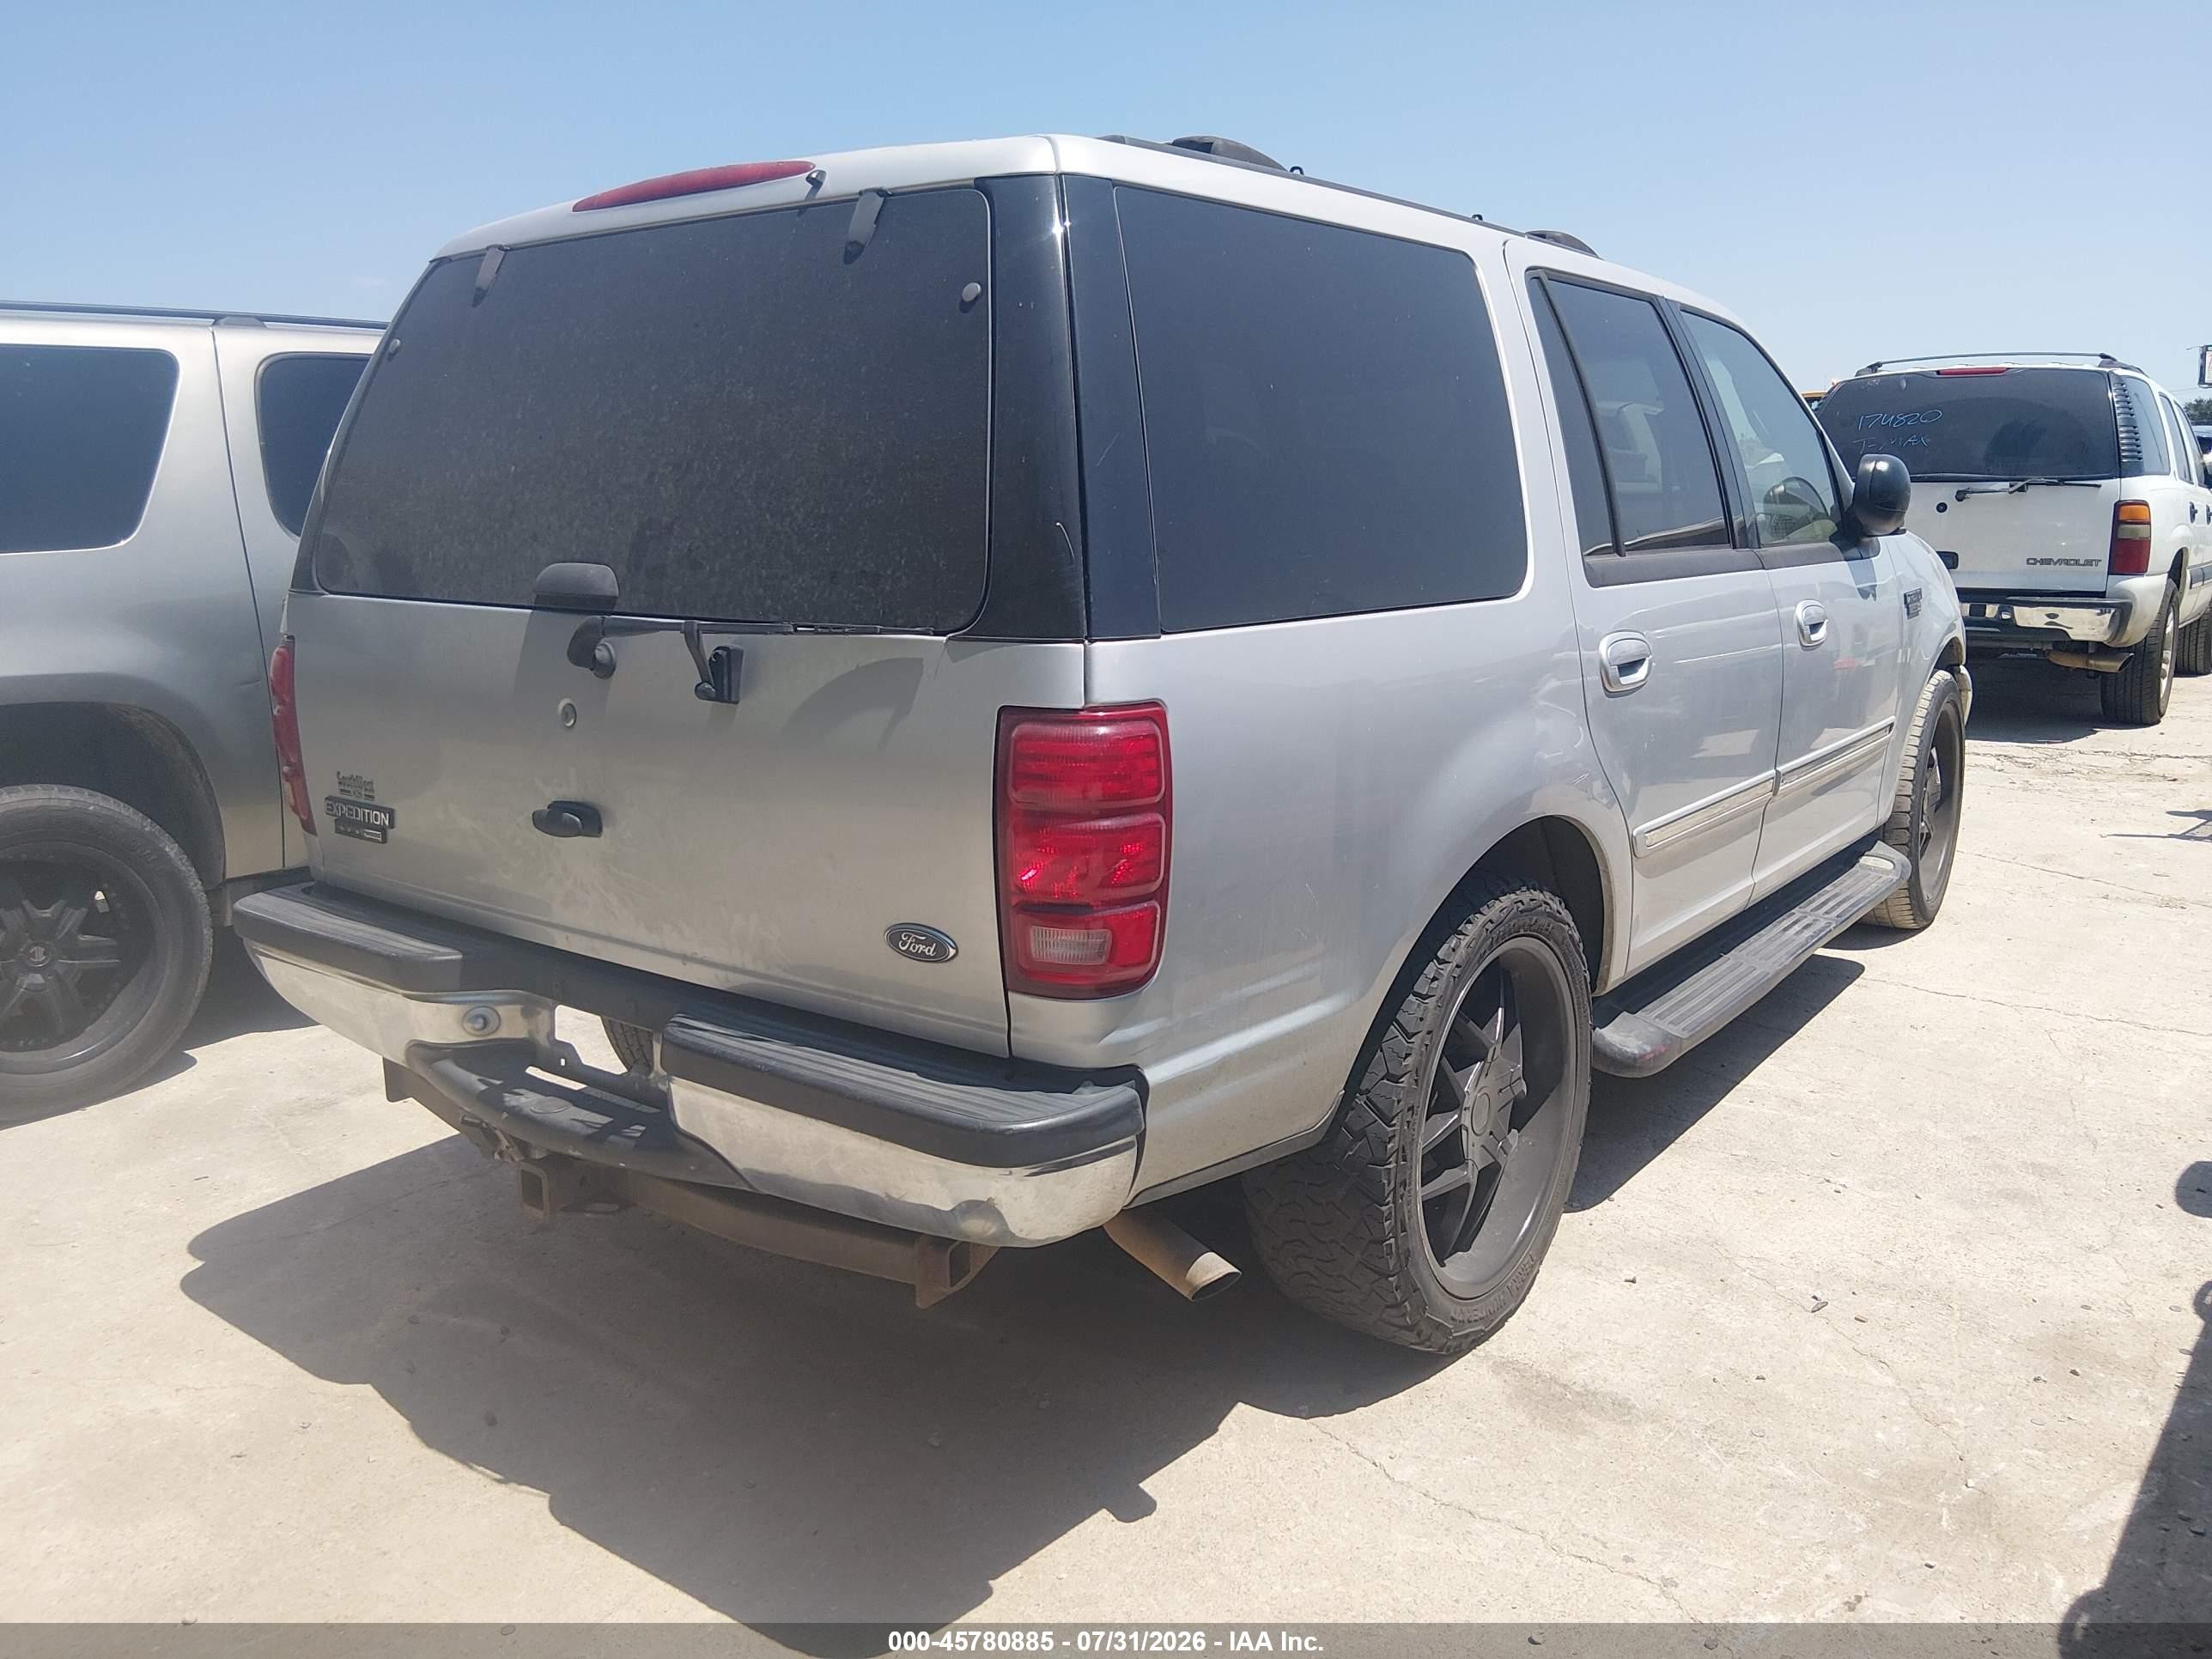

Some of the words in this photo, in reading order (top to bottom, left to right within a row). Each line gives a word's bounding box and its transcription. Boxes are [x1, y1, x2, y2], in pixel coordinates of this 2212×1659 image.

[1857, 409, 1943, 431] 174820
[2026, 557, 2102, 568] CHEVROLET
[325, 799, 390, 826] EXPEDITION
[898, 931, 937, 957] Ford
